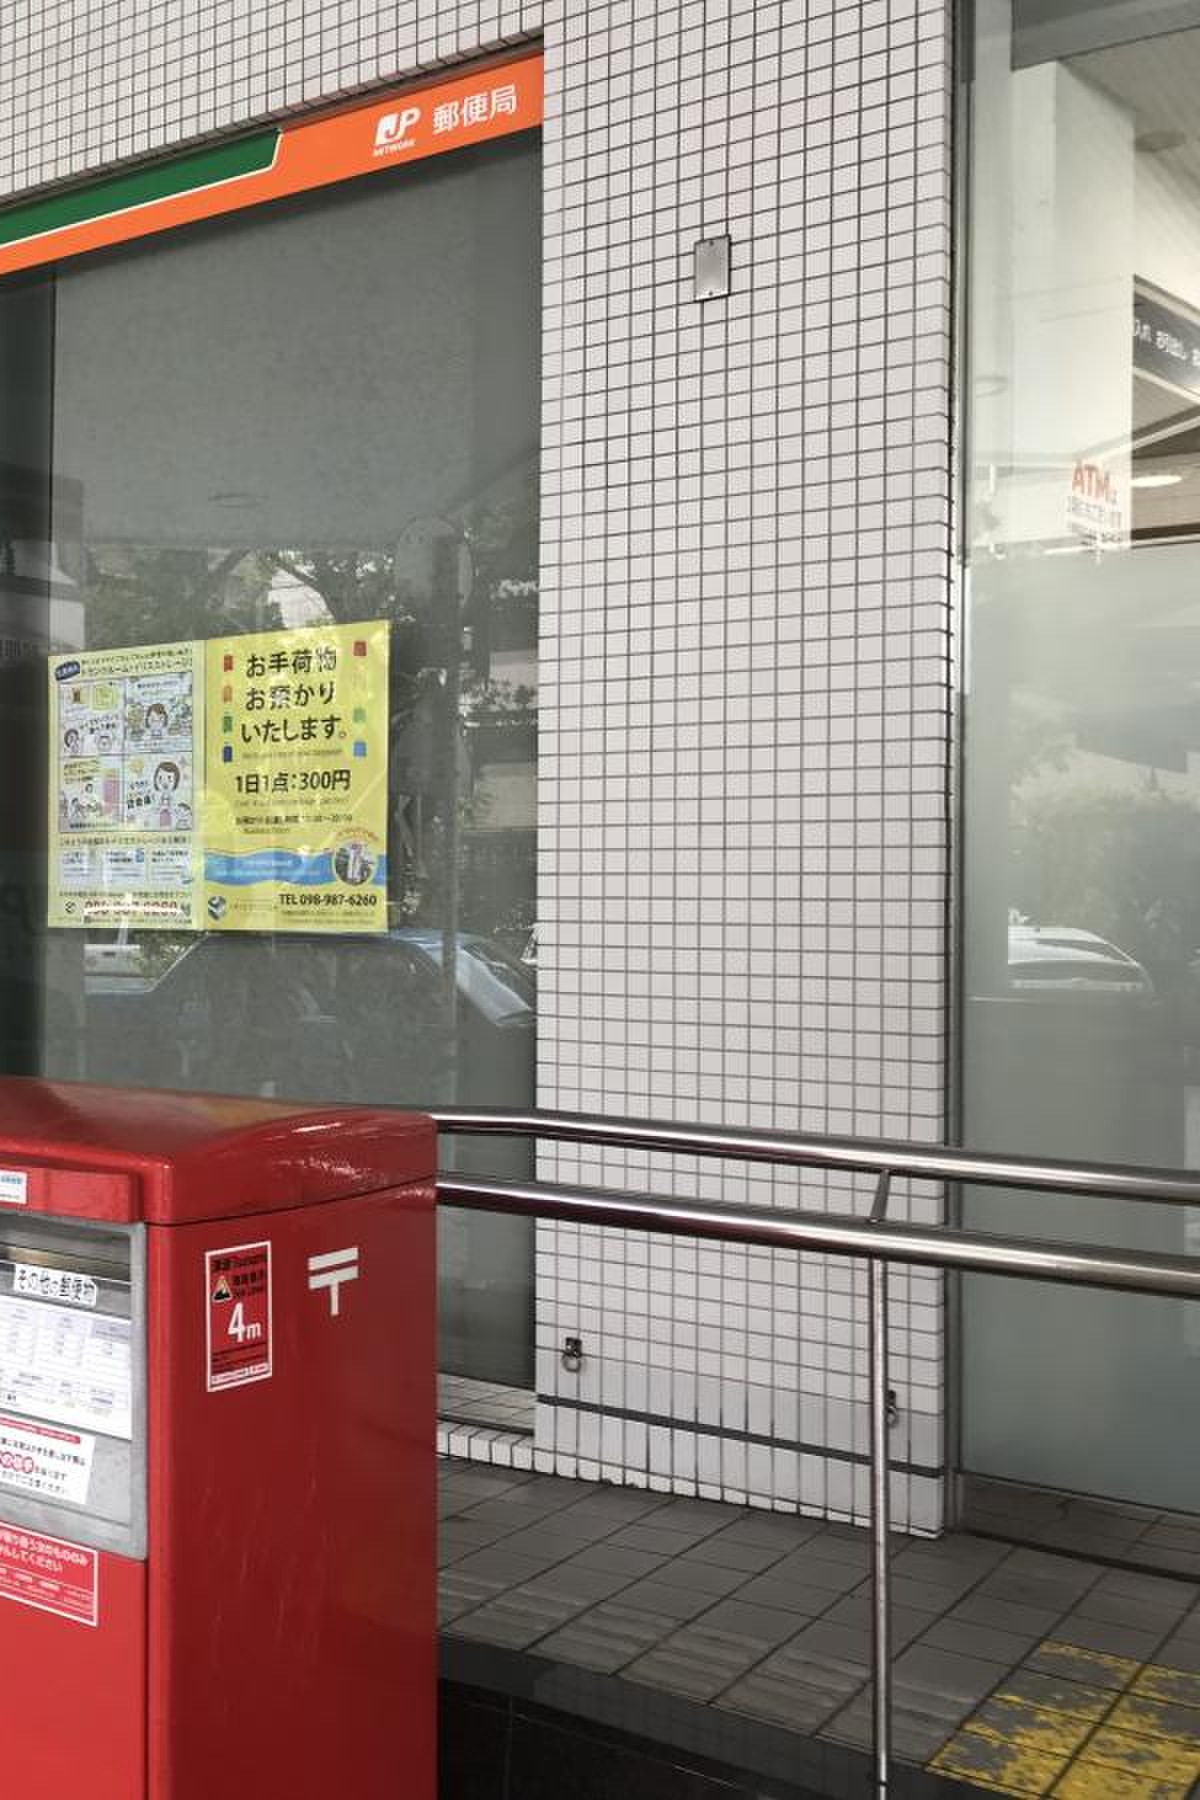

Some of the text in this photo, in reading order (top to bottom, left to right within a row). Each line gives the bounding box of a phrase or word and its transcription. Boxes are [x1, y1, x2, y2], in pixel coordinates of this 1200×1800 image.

[432, 83, 517, 135] 郵便局
[246, 649, 336, 678] お手荷物
[245, 680, 335, 711] お預かり
[241, 714, 346, 744] いたします。
[279, 893, 298, 906] TEL
[17, 1268, 94, 1302] その他の郵便物
[228, 1302, 262, 1342] 4m
